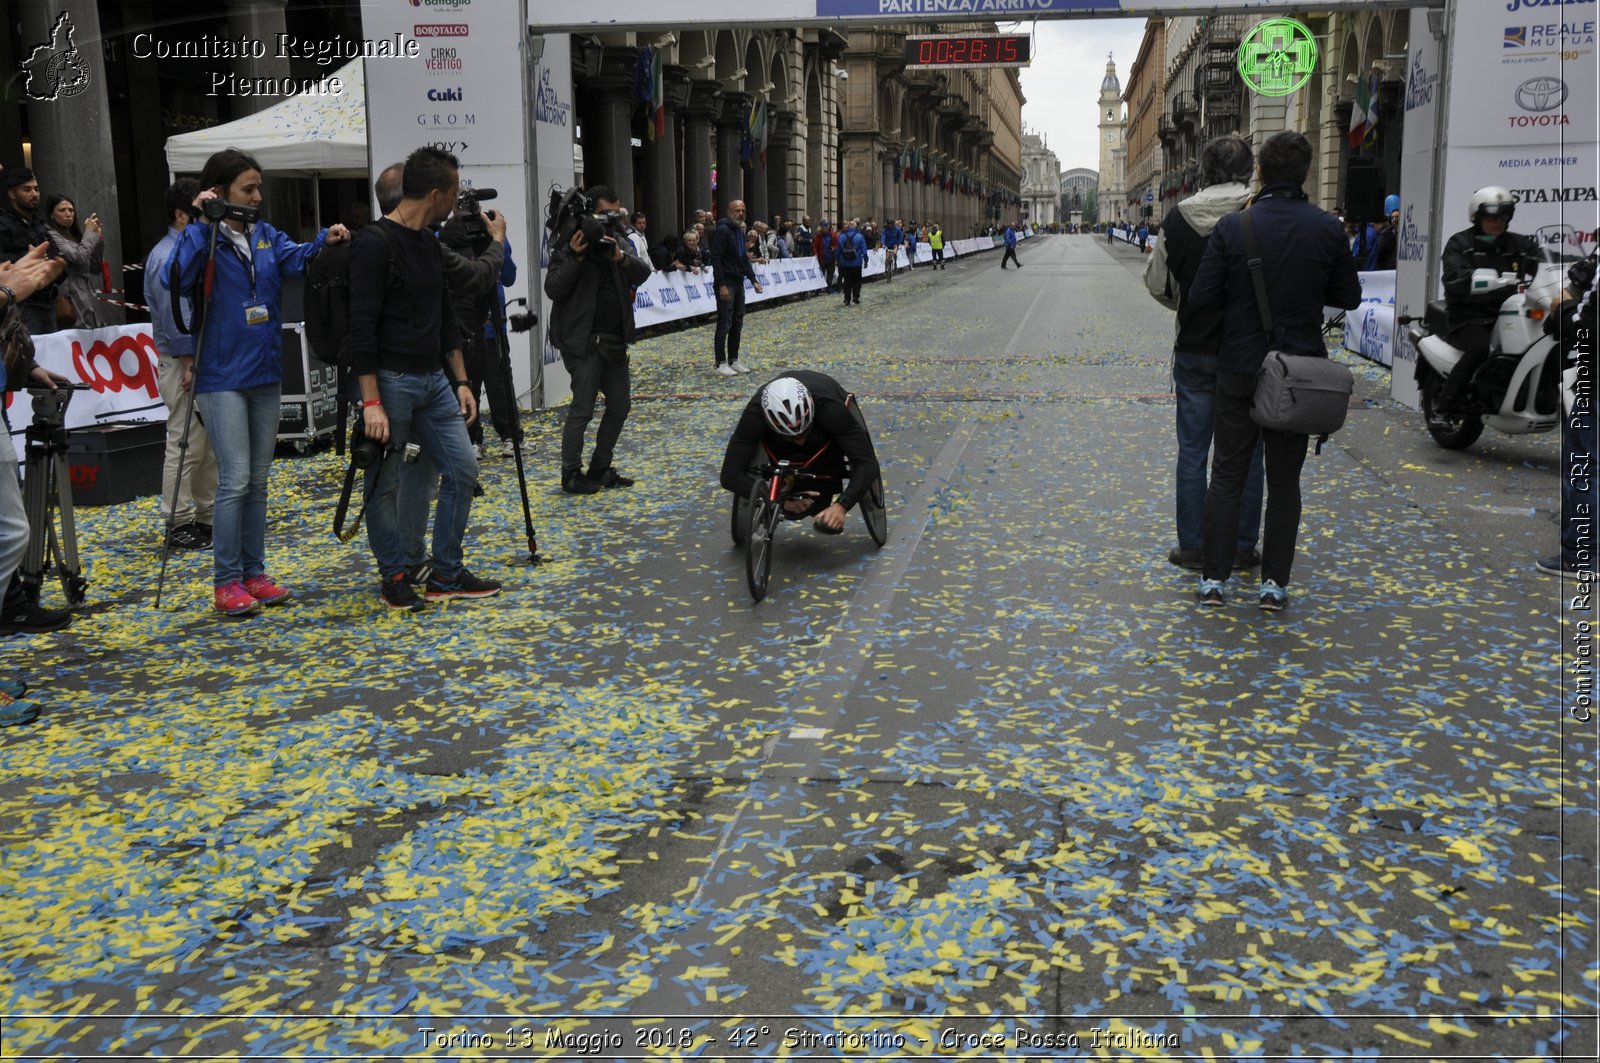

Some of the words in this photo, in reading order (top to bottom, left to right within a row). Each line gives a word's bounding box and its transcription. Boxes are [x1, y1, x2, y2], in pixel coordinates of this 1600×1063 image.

[415, 26, 468, 37] BOROTALCO
[1531, 21, 1595, 37] REALE
[1530, 35, 1594, 47] MUTUA
[431, 47, 457, 59] CIRKO
[919, 39, 1018, 63] 00:28:15
[427, 87, 463, 102] Cuki
[417, 114, 475, 125] GROM
[1508, 115, 1570, 128] TOYOTA
[1499, 159, 1531, 168] MEDIA
[1534, 157, 1578, 167] PARTNER
[1509, 187, 1598, 204] STAMPA
